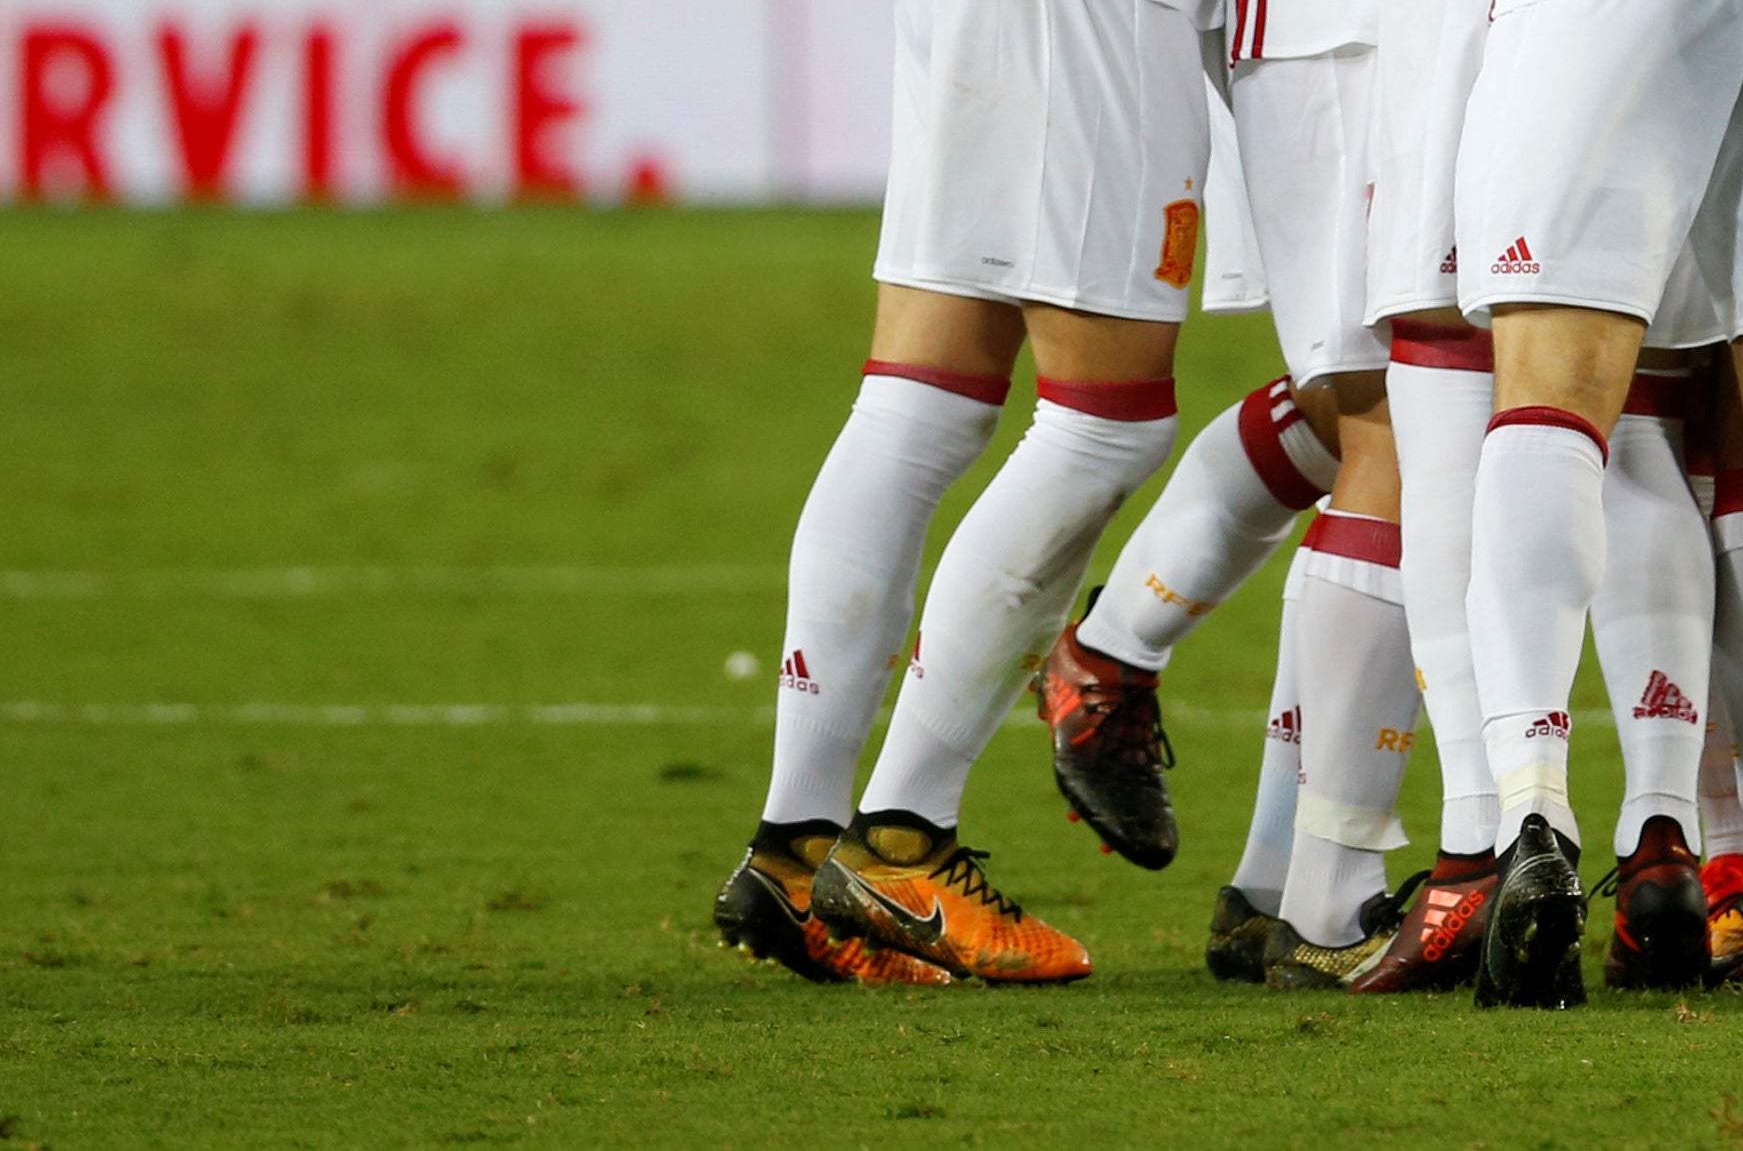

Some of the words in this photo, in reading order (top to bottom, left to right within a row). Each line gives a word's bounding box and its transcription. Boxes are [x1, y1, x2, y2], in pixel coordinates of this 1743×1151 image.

[1490, 258, 1541, 275] adidas
[1375, 725, 1416, 754] RF
[1423, 889, 1485, 962] adidas
